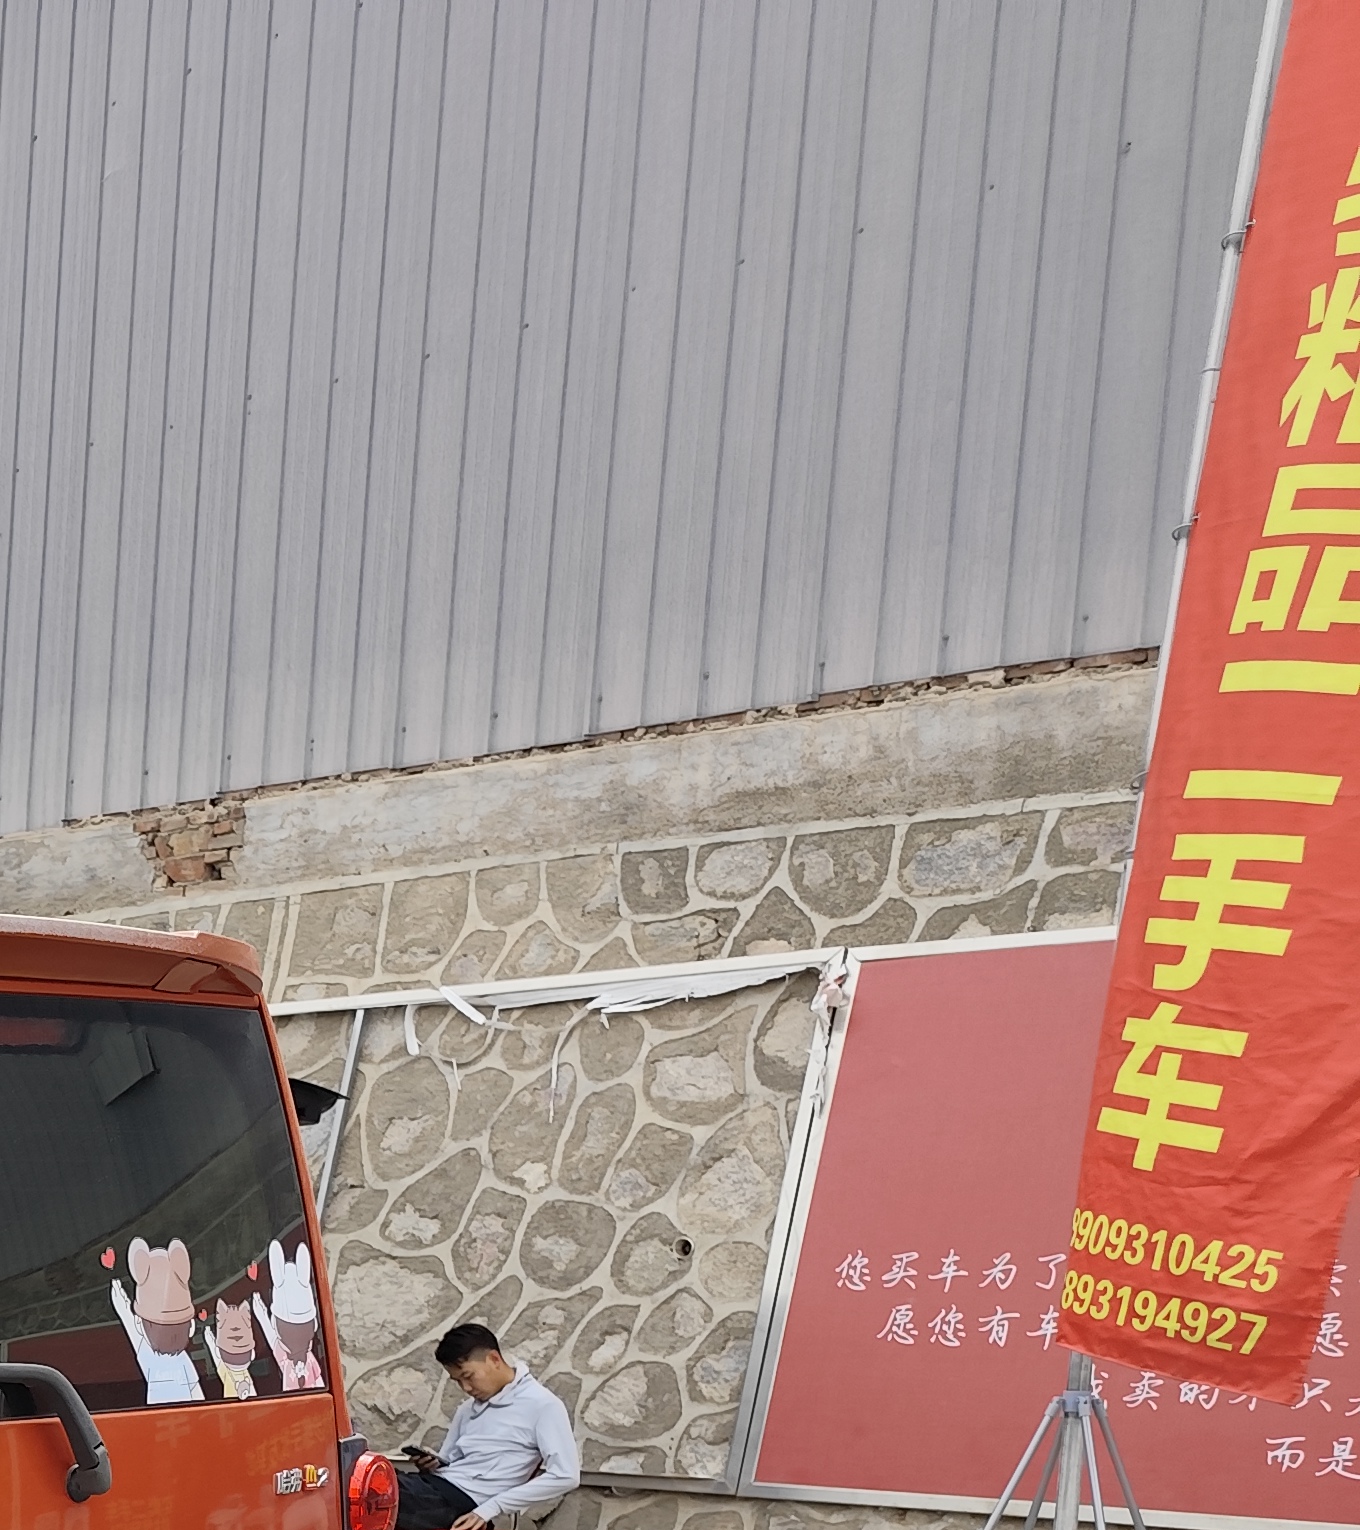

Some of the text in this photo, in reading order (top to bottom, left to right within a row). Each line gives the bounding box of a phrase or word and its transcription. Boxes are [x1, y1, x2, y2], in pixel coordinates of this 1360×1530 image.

[835, 1249, 1067, 1293] 您买车为了
[877, 1304, 1060, 1350] 愿您有车
